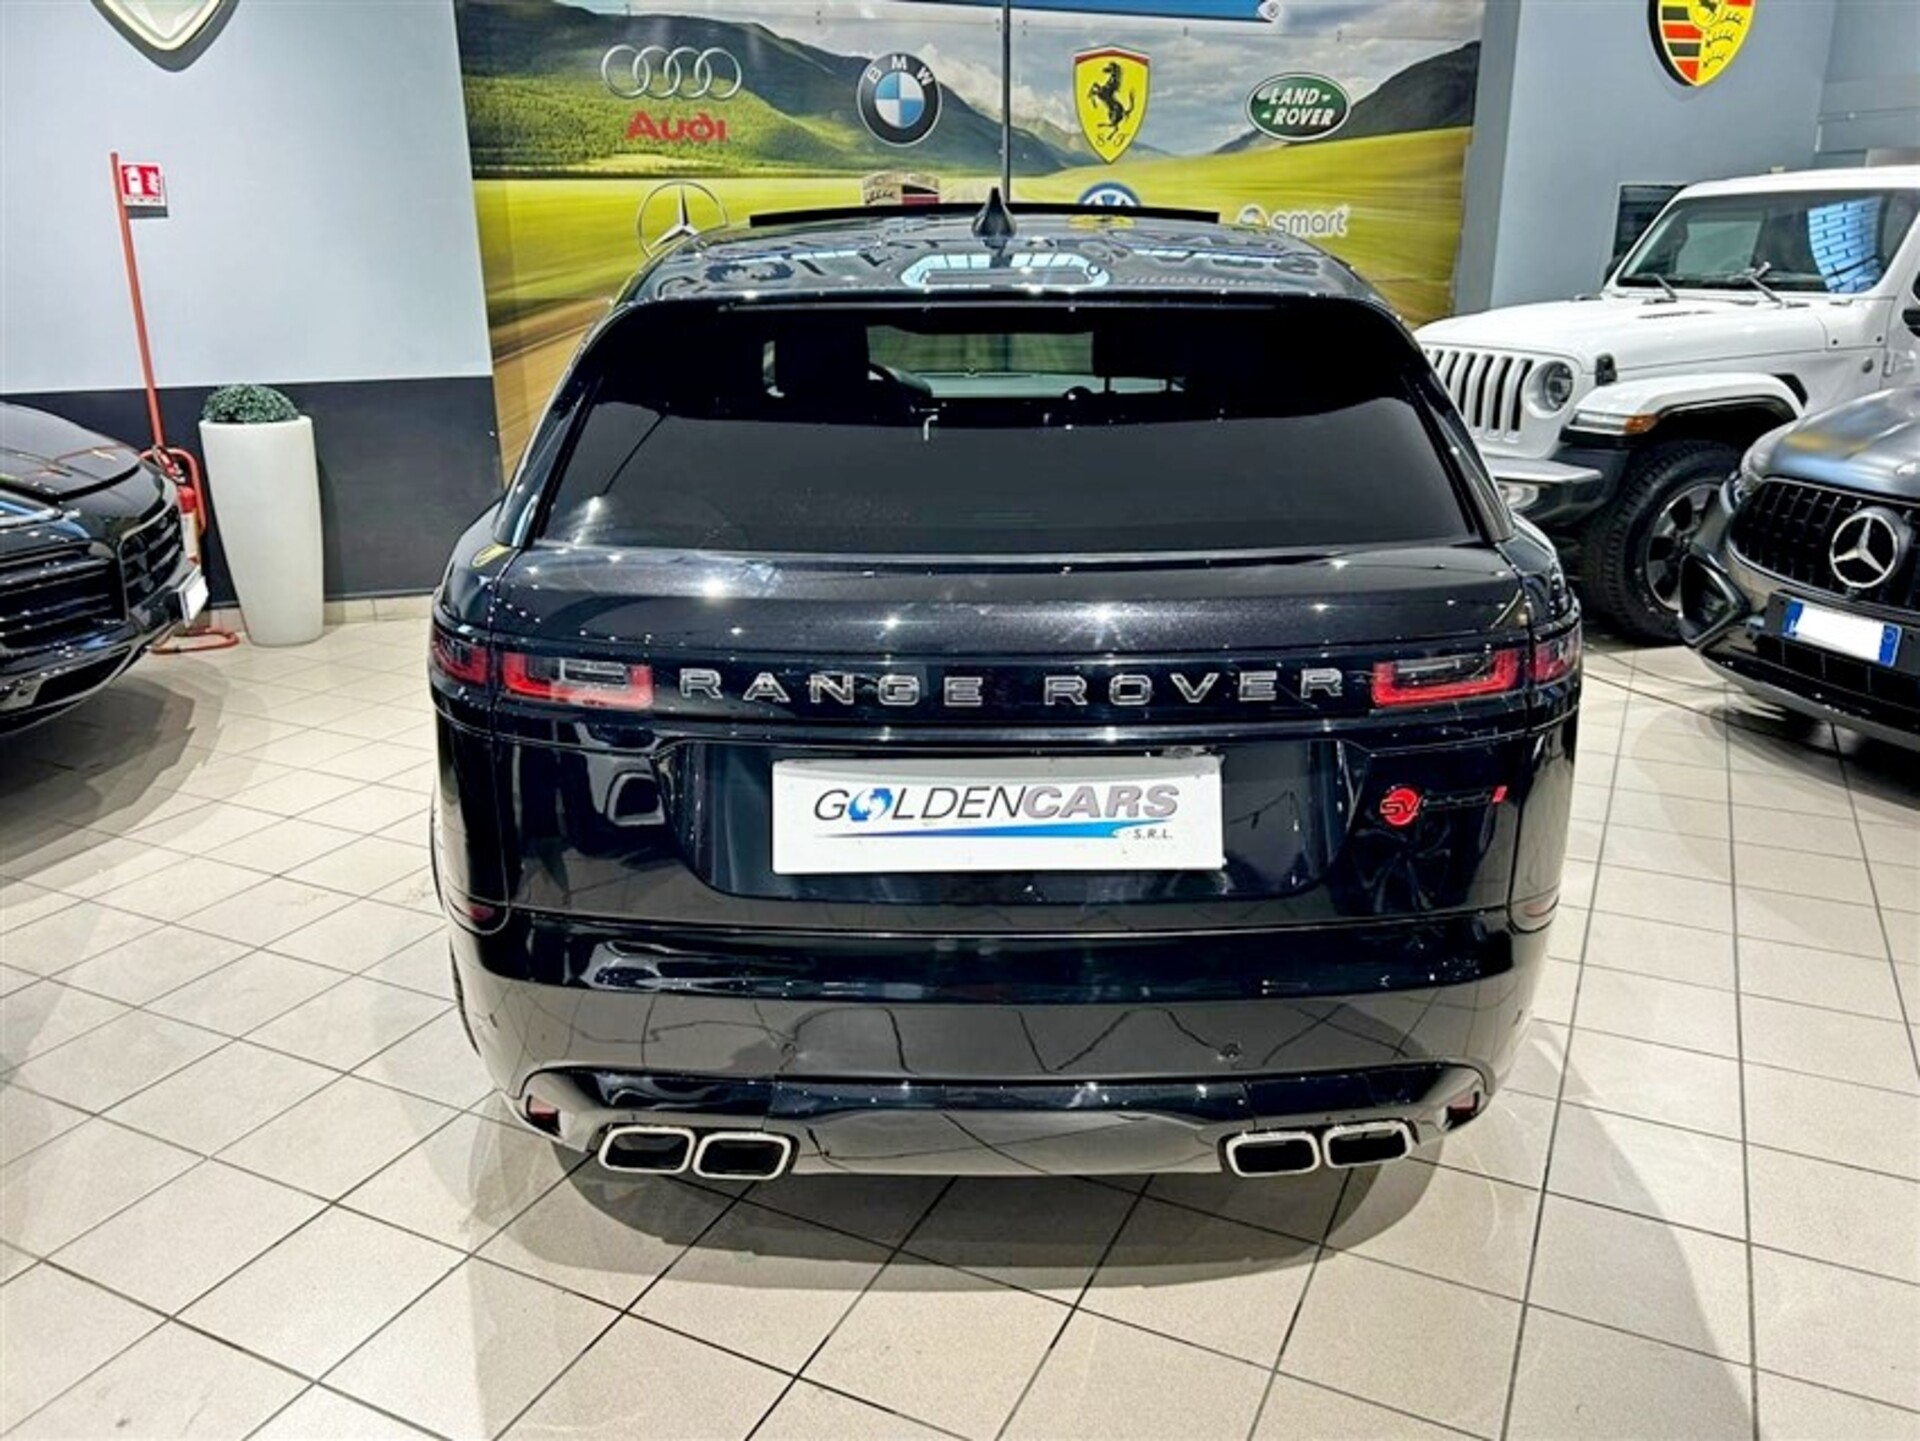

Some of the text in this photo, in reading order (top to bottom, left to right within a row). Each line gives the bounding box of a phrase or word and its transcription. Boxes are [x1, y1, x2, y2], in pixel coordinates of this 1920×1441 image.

[866, 55, 934, 86] BMW
[1268, 87, 1320, 105] LAND
[624, 111, 729, 141] Audi
[1272, 107, 1335, 125] ROVER
[1272, 207, 1345, 234] smart
[679, 667, 1344, 707] RANGE ROVER
[1133, 828, 1173, 839] S.R.L.
